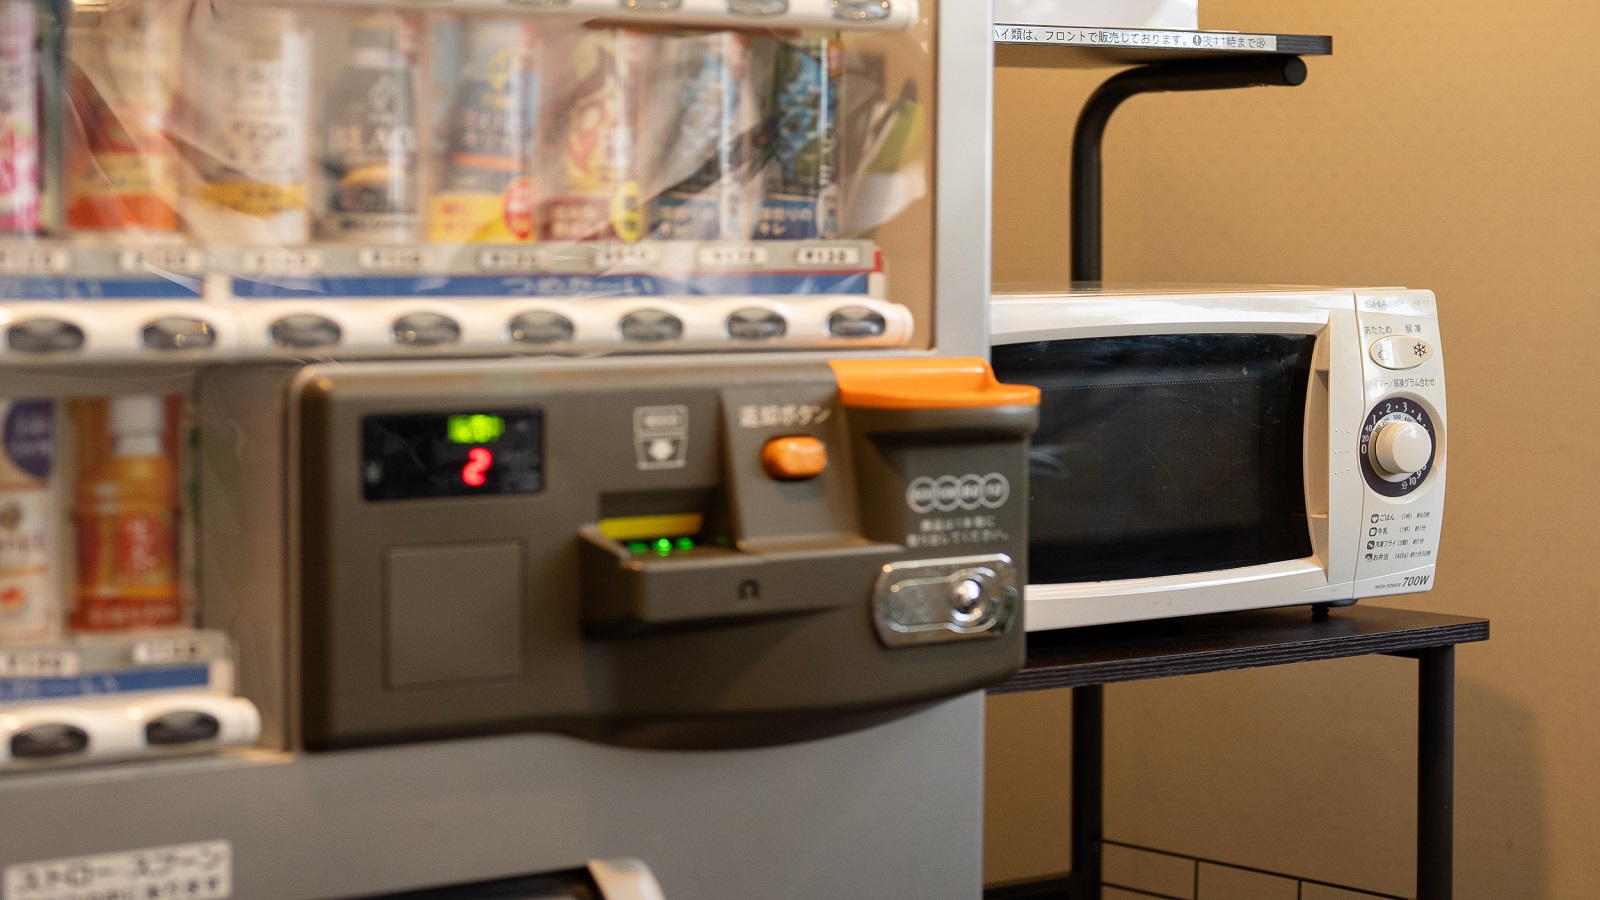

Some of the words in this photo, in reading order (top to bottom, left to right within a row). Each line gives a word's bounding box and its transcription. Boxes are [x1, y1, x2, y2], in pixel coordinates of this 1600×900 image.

[1364, 300, 1404, 309] SHARP
[1364, 325, 1393, 335] あたため
[1386, 403, 1391, 413] 2
[1403, 402, 1408, 412] 3
[1372, 414, 1377, 424] 1
[1416, 412, 1422, 422] 4
[1365, 424, 1373, 433] 40
[1361, 435, 1370, 443] 20
[1409, 477, 1417, 486] 10
[1379, 513, 1396, 522] ごはん
[1402, 575, 1430, 587] 700W
